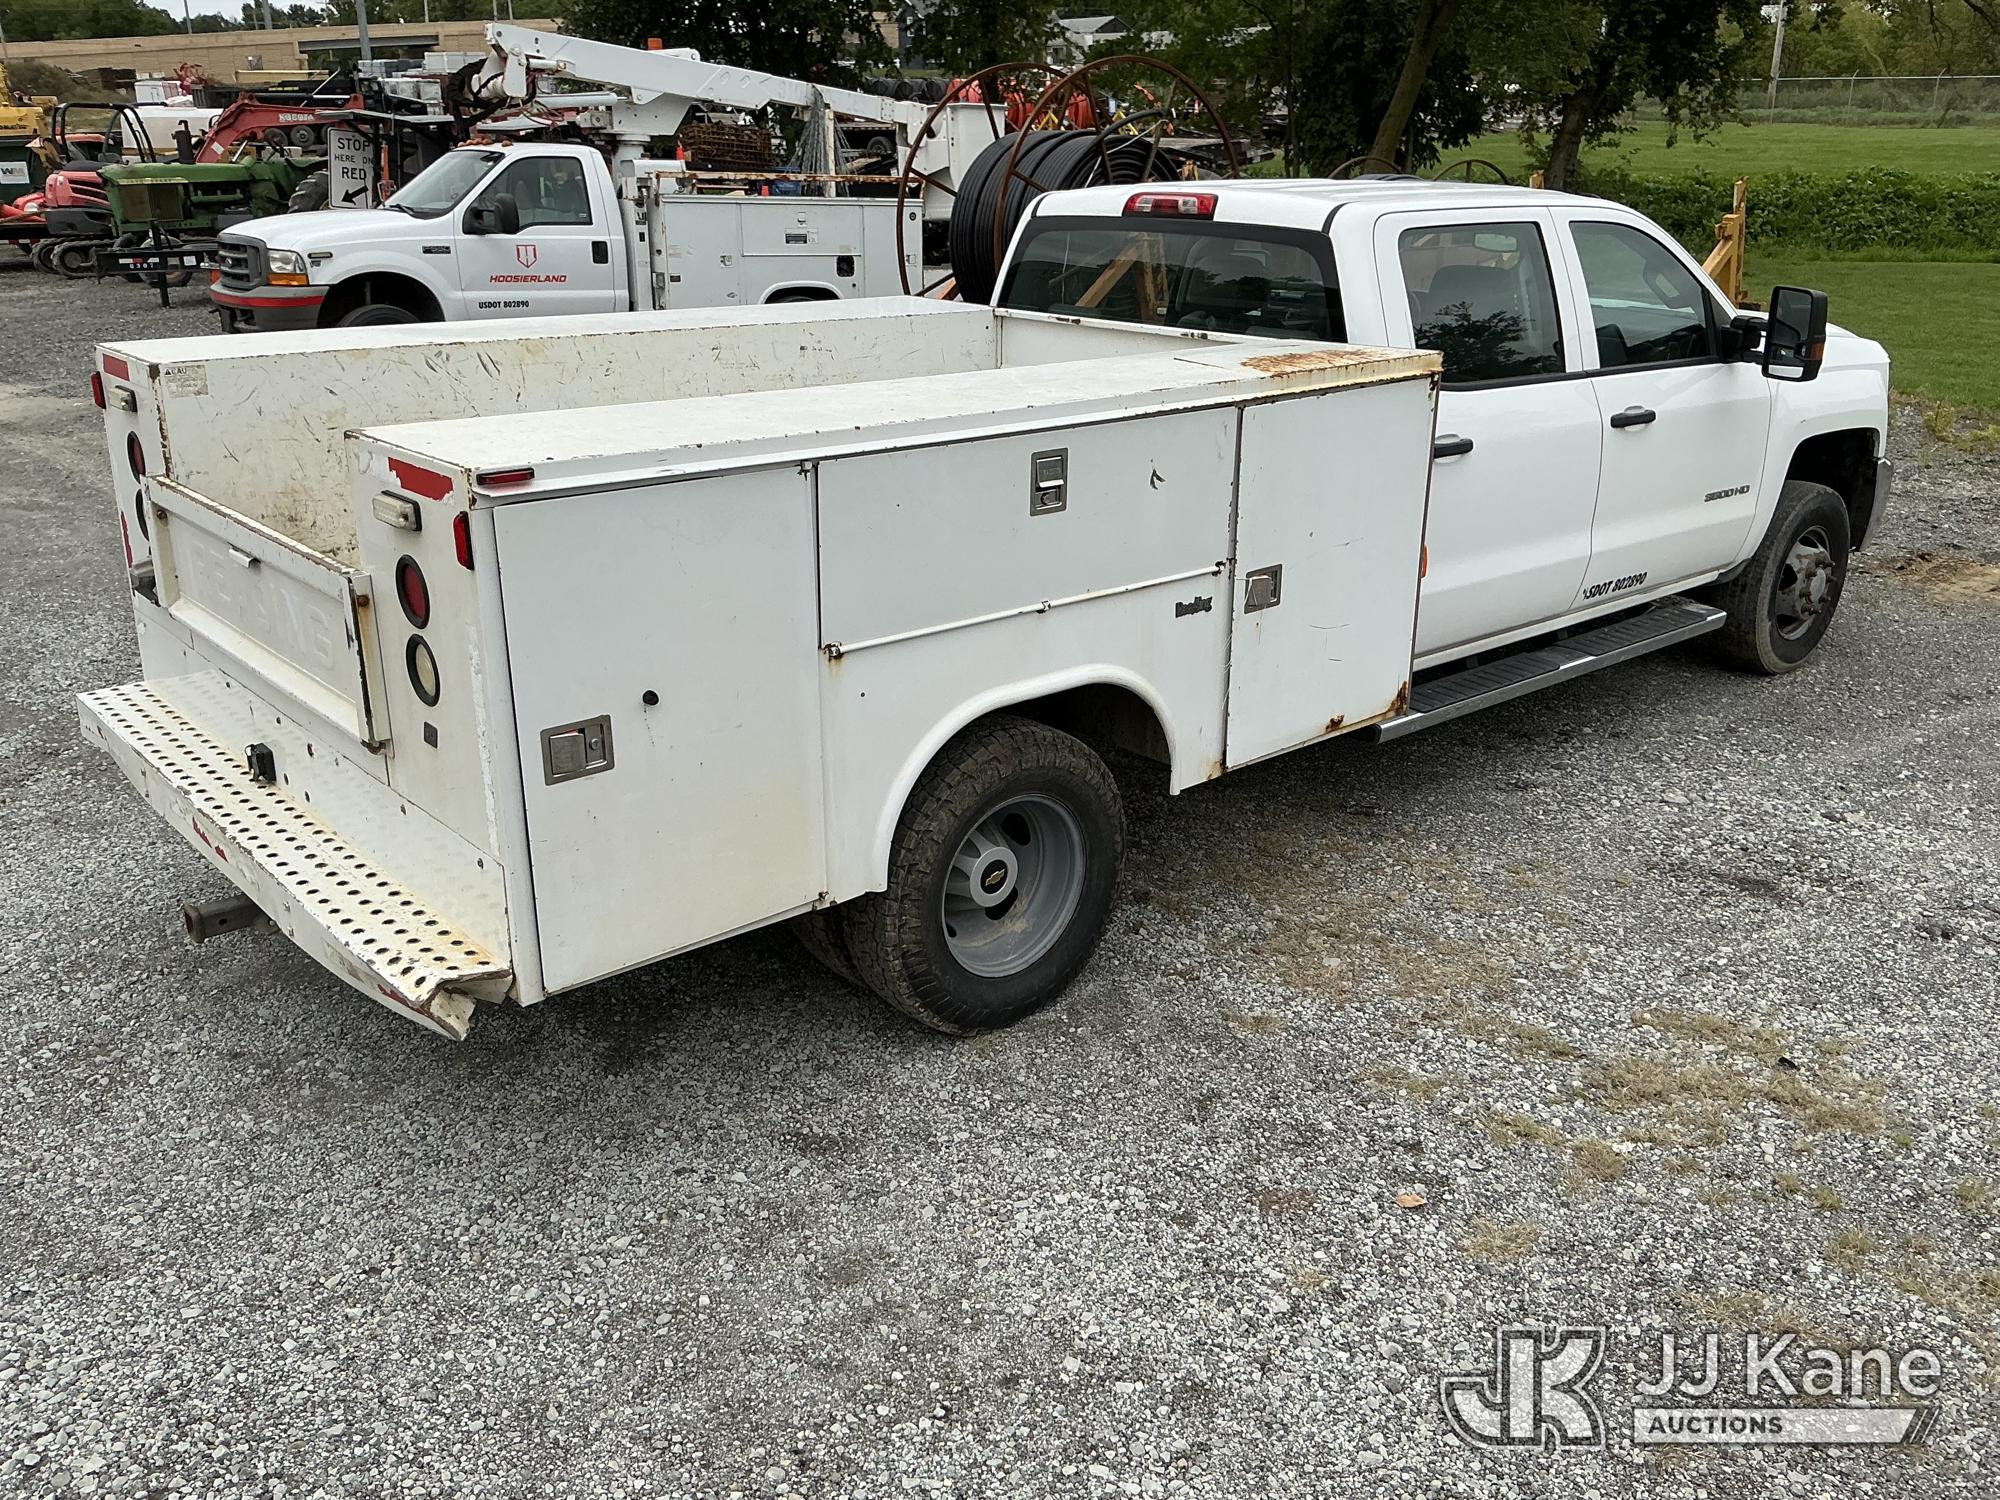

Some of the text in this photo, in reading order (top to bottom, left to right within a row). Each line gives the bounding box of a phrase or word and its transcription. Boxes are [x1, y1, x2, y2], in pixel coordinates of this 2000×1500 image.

[337, 137, 370, 152] STOP
[334, 154, 356, 163] HERE
[341, 166, 367, 180] RED
[489, 275, 567, 283] HOOSIERLAND
[478, 300, 530, 309] USDOT 802890
[1611, 571, 1648, 593] 802890
